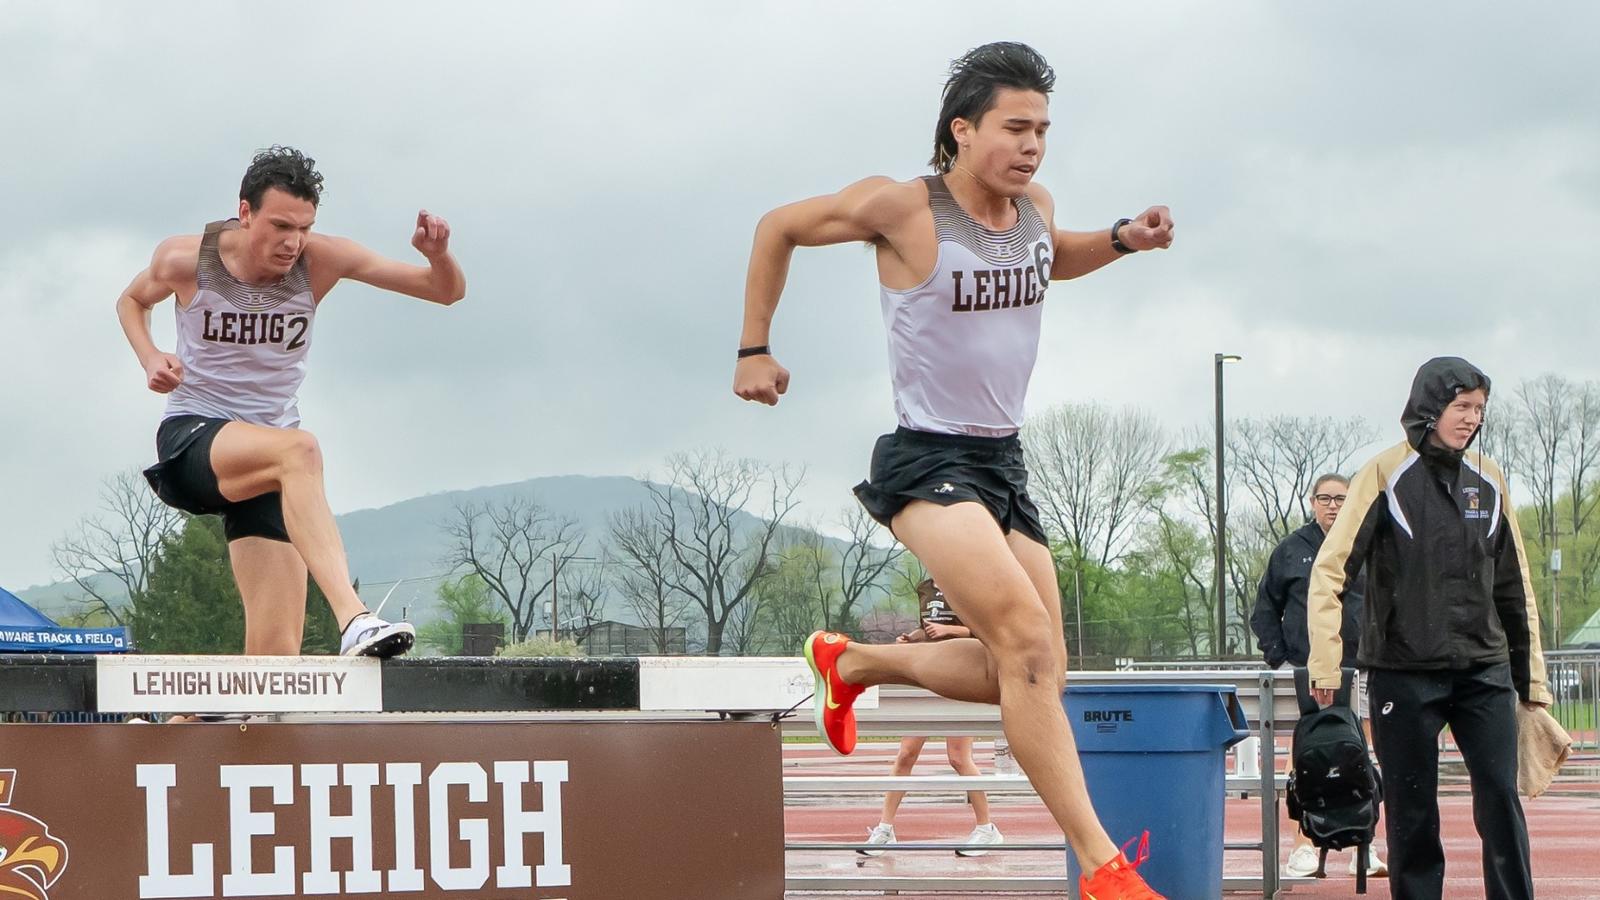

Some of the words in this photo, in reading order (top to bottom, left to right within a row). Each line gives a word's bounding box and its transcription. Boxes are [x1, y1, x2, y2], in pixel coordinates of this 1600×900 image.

[1034, 242, 1050, 287] 6
[952, 265, 1044, 312] LEHIG
[202, 310, 305, 344] LEHIG
[286, 317, 308, 351] 2
[37, 632, 73, 643] TRACK
[75, 635, 83, 643] &
[85, 633, 114, 644] FIELD
[133, 672, 211, 695] LEHIGH
[218, 672, 347, 695] UNIVERSITY
[1084, 710, 1133, 722] BRUTE
[136, 760, 571, 898] LEHIGH
